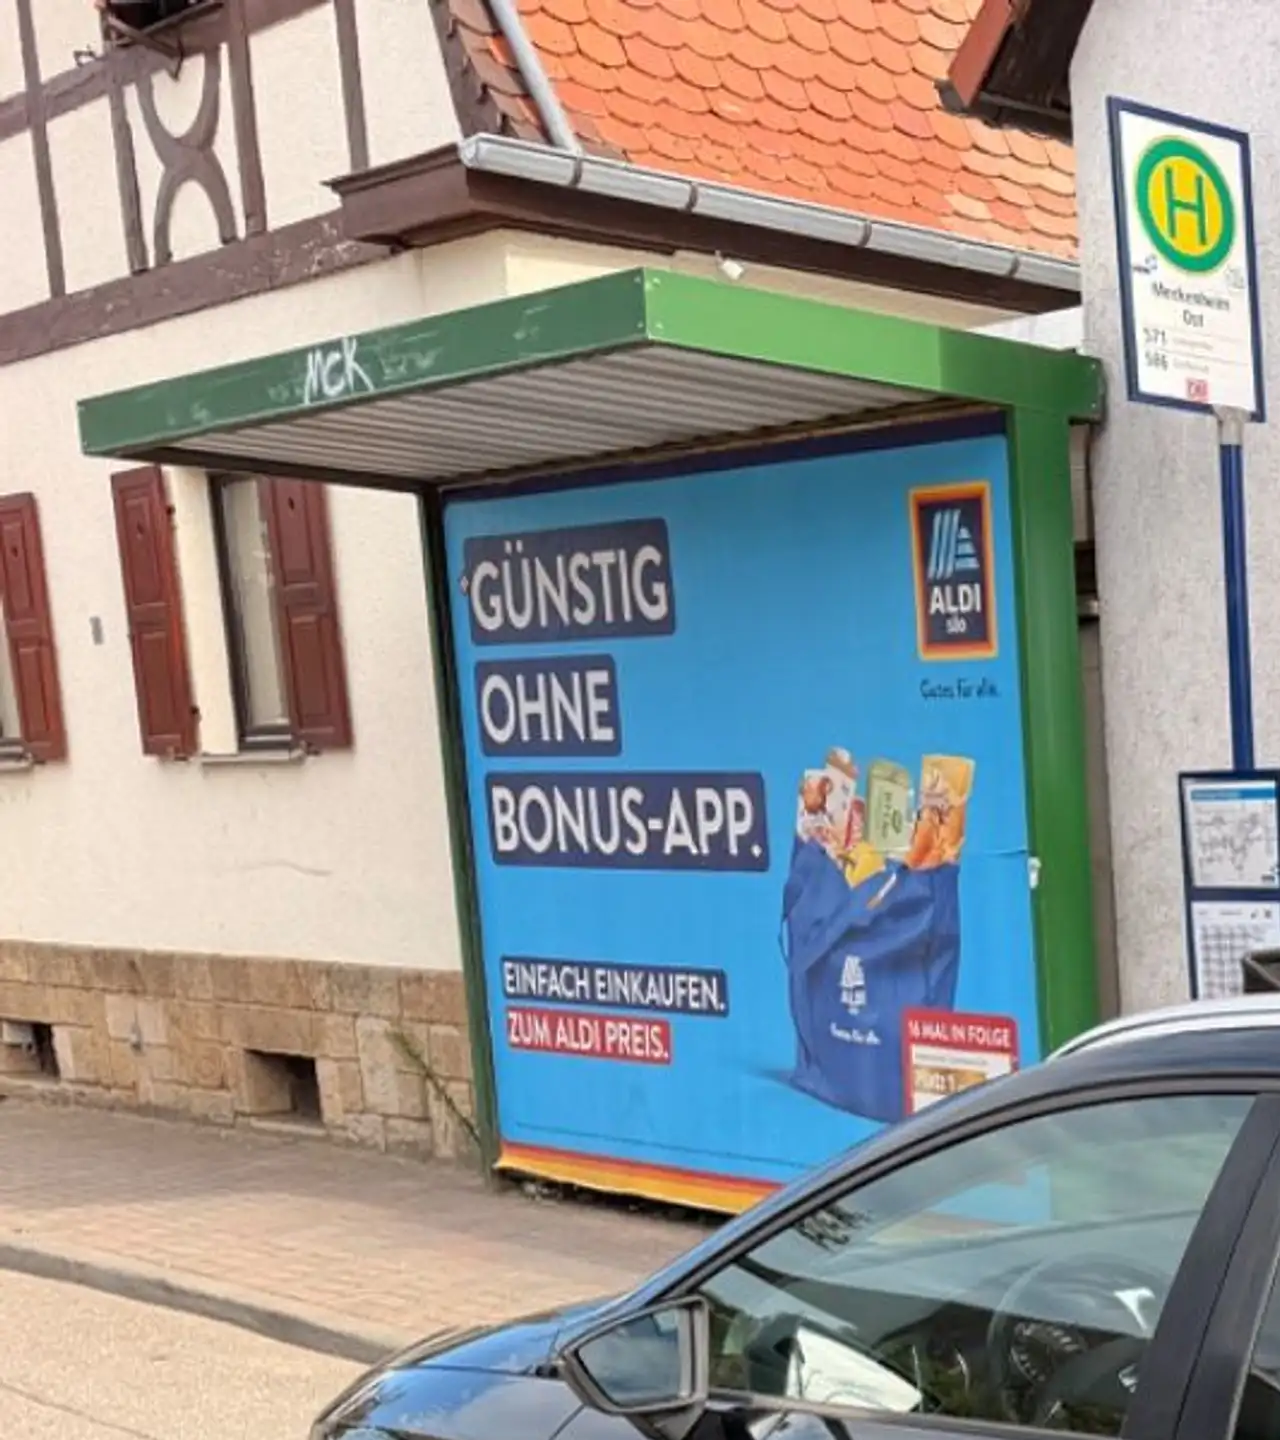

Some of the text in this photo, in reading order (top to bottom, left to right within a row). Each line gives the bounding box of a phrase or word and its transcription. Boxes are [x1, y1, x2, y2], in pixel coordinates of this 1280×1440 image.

[1164, 166, 1207, 246] H
[1152, 281, 1231, 311] Meckenheim
[1143, 327, 1166, 345] 571
[470, 539, 669, 631] GÜNSTIG
[929, 583, 982, 615] ALDI
[481, 669, 615, 744] OHNE
[490, 785, 763, 858] BONUS-APP.
[503, 961, 726, 1011] EINFACH EINKAUFEN.
[507, 1010, 669, 1059] ZUM ALDI PREIS.
[921, 1022, 949, 1042] MAL
[951, 1024, 966, 1043] IN
[967, 1025, 1012, 1048] FOLGE
